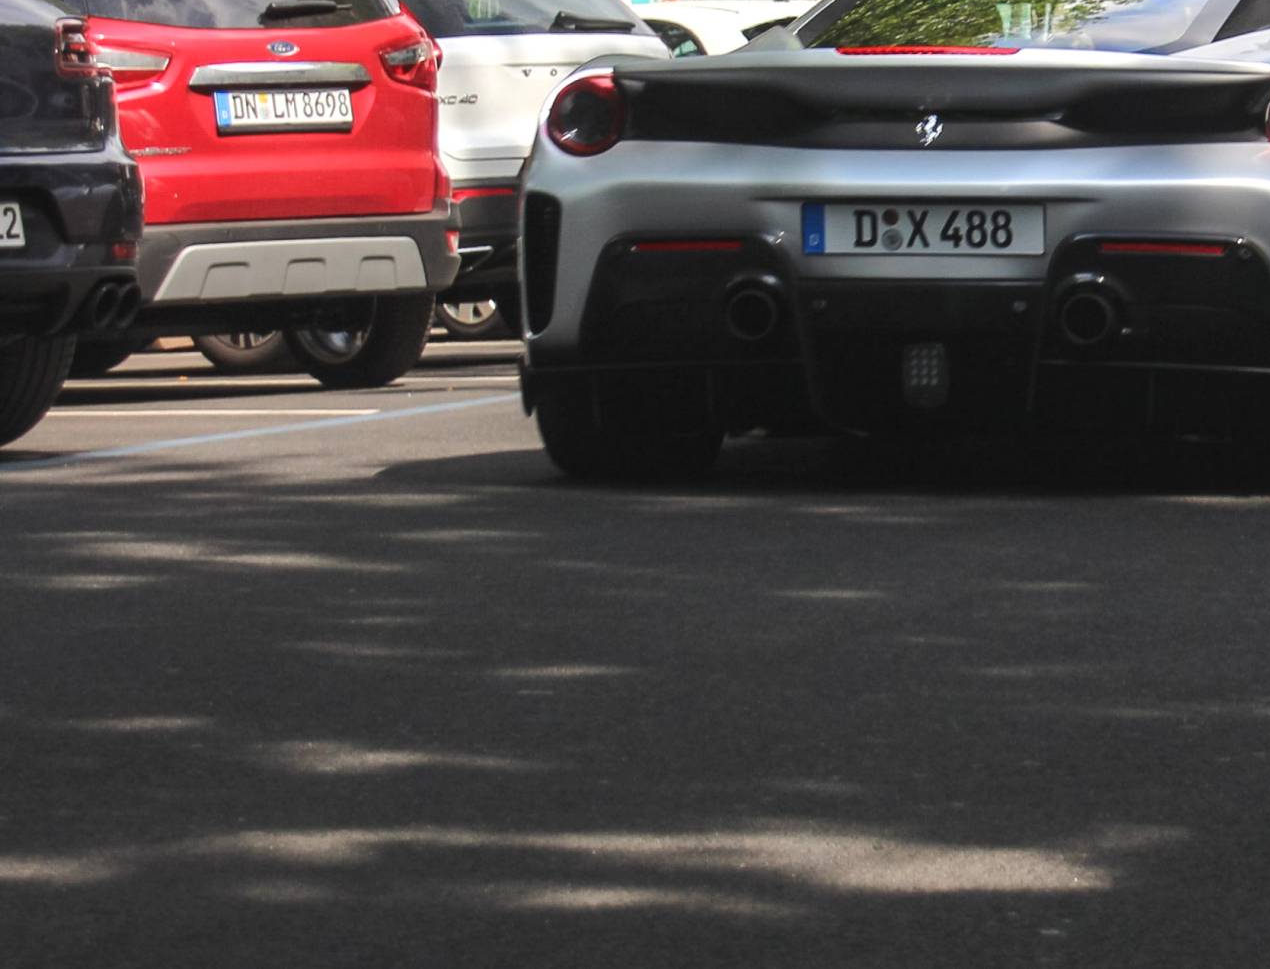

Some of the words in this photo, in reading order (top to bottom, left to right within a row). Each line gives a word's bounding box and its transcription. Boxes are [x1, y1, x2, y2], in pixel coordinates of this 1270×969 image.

[232, 93, 259, 120] DN
[271, 92, 298, 119] LM
[302, 91, 349, 118] 8698
[0, 206, 20, 240] 2
[853, 209, 878, 248] D
[906, 209, 931, 248] X
[939, 209, 1014, 249] 488
